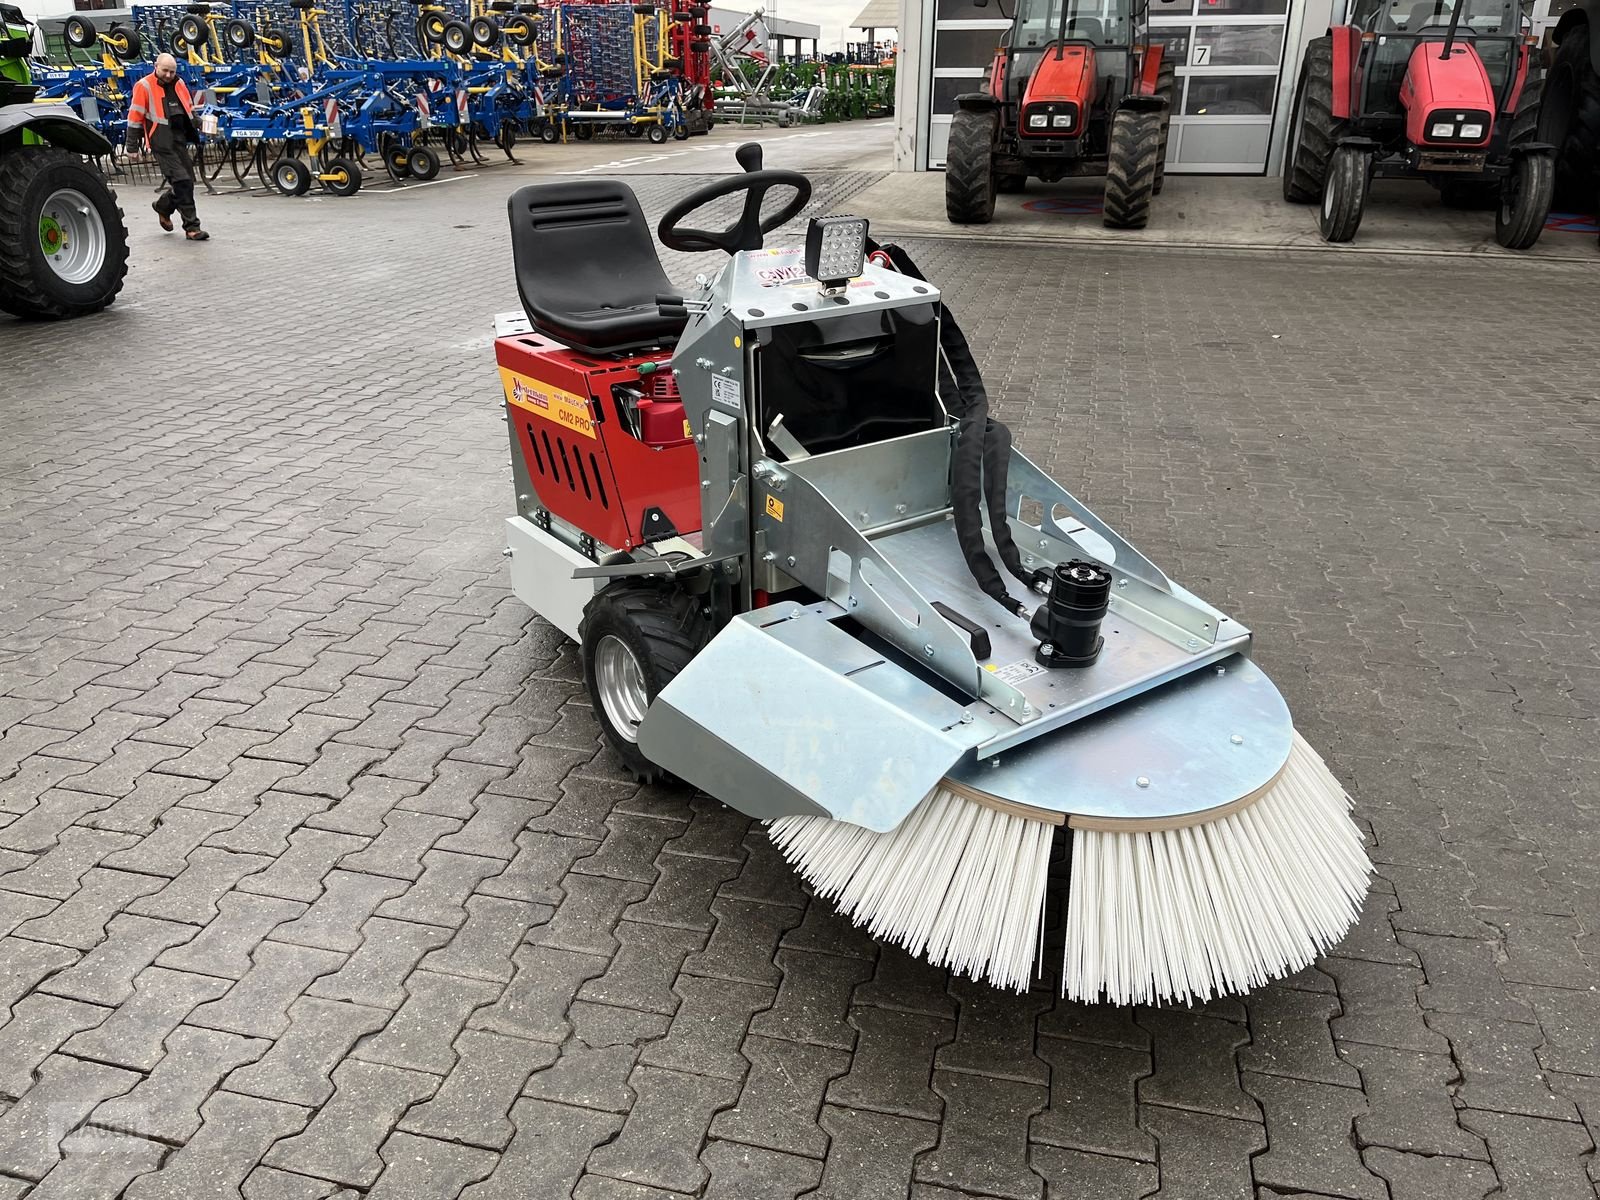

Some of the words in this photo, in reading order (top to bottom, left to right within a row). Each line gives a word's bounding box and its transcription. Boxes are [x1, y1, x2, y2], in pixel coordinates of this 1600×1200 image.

[1197, 48, 1207, 64] 7
[558, 409, 574, 425] CM2
[575, 415, 590, 431] PRO
